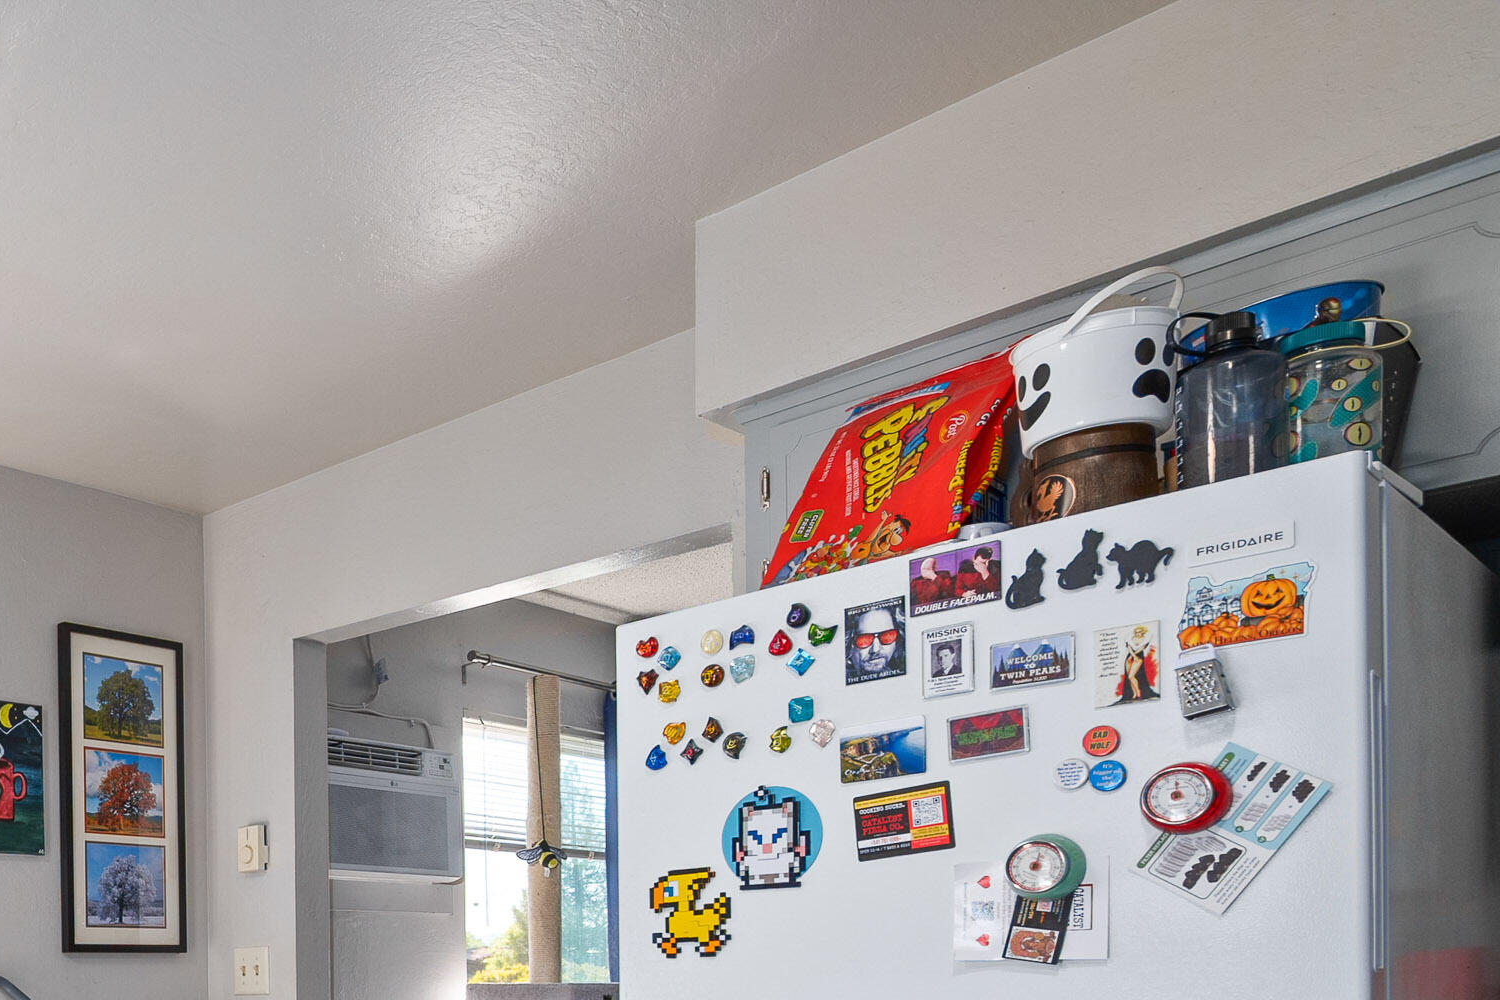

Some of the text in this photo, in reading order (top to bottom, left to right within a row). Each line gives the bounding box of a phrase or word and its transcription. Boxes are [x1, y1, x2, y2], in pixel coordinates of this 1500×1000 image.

[946, 414, 966, 438] Post
[894, 395, 950, 486] FRUITY
[861, 403, 916, 513] PEBBLES
[797, 518, 809, 536] FREE
[803, 514, 818, 538] GLUTEN
[1196, 531, 1283, 556] FRIGIDAIRE
[914, 592, 998, 615] DOUBLE FACEPALM.
[927, 625, 968, 639] MISSING
[1006, 653, 1054, 665] WELCOME
[860, 673, 878, 682] DUDE
[1000, 665, 1061, 680] TWIN PEAKS
[1092, 731, 1109, 739] BAD
[1090, 741, 1111, 750] WOLF
[861, 814, 903, 827] CATALYST
[863, 826, 888, 836] PIZZA
[1073, 888, 1084, 928] CATALYST
